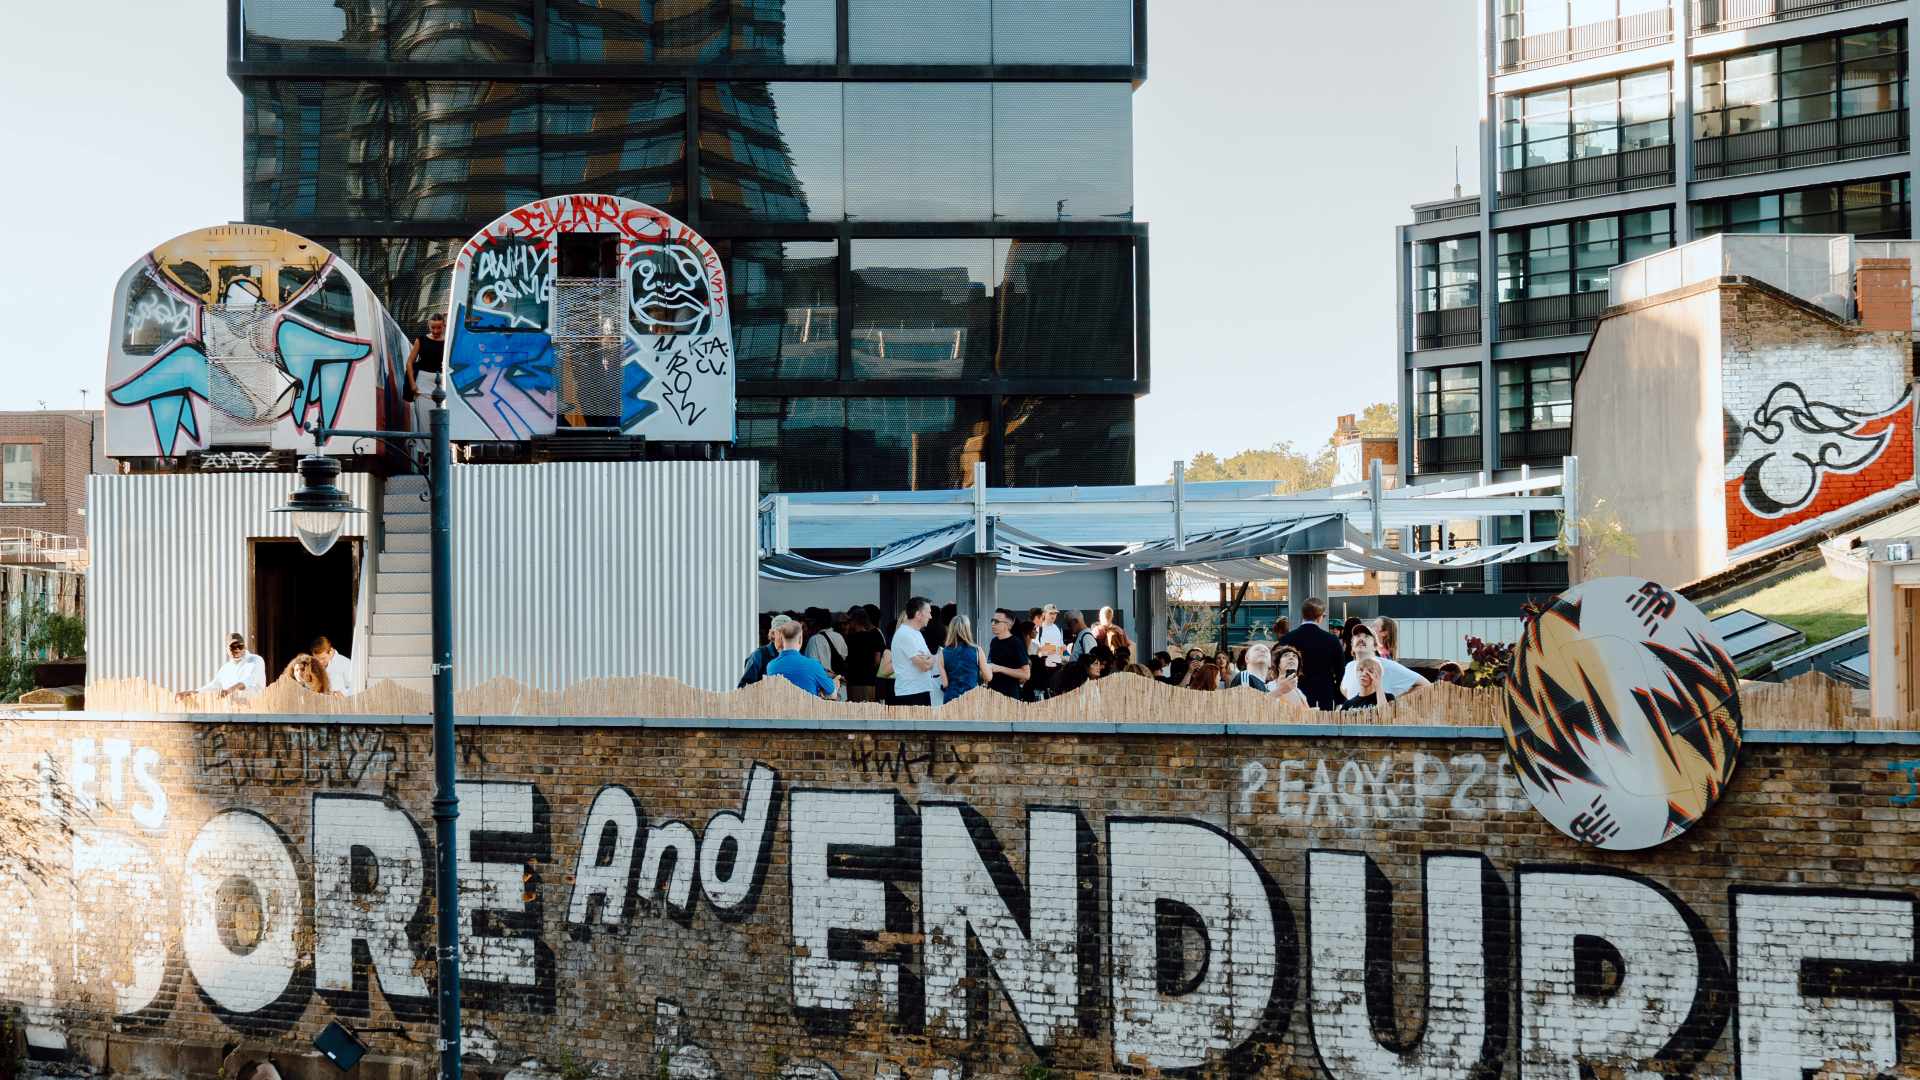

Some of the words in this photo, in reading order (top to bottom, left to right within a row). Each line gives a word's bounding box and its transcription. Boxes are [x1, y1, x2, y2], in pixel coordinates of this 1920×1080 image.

[0, 778, 550, 1030] DORE
[566, 760, 782, 935] And
[788, 787, 1920, 1080] ENDURE
